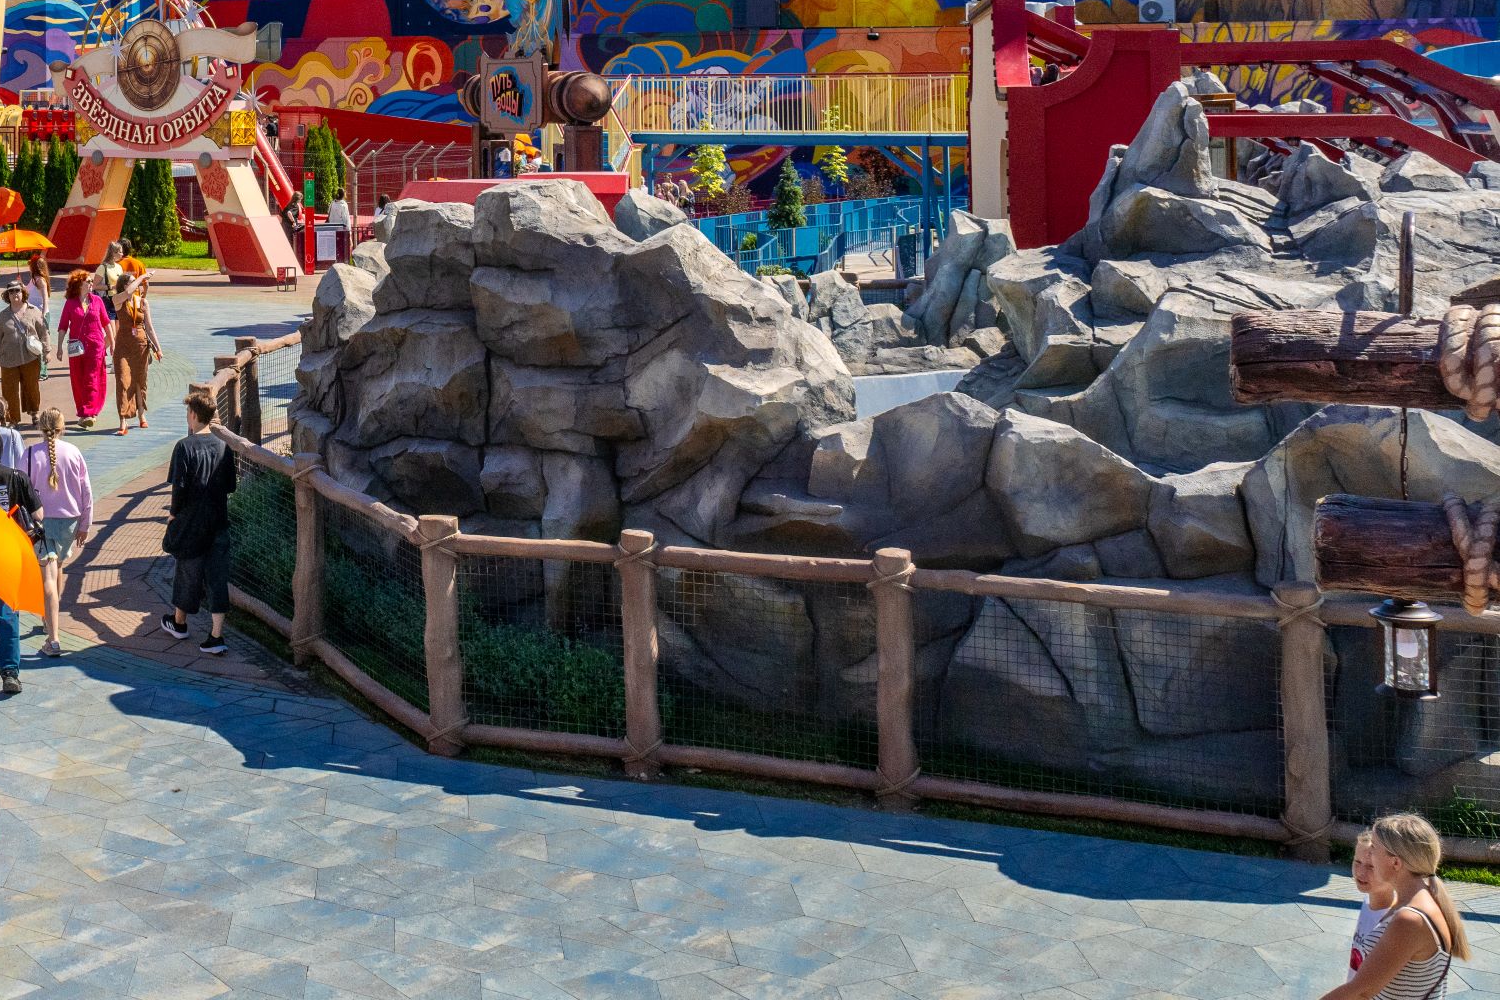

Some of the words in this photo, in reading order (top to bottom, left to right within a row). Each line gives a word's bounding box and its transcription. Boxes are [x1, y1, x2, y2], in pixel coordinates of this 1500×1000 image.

[489, 73, 513, 98] ПУТЬ
[72, 80, 157, 145] ЗВЁЗДНАЯ
[160, 83, 228, 142] ОРБИТА
[496, 90, 519, 117] ВОДЫ
